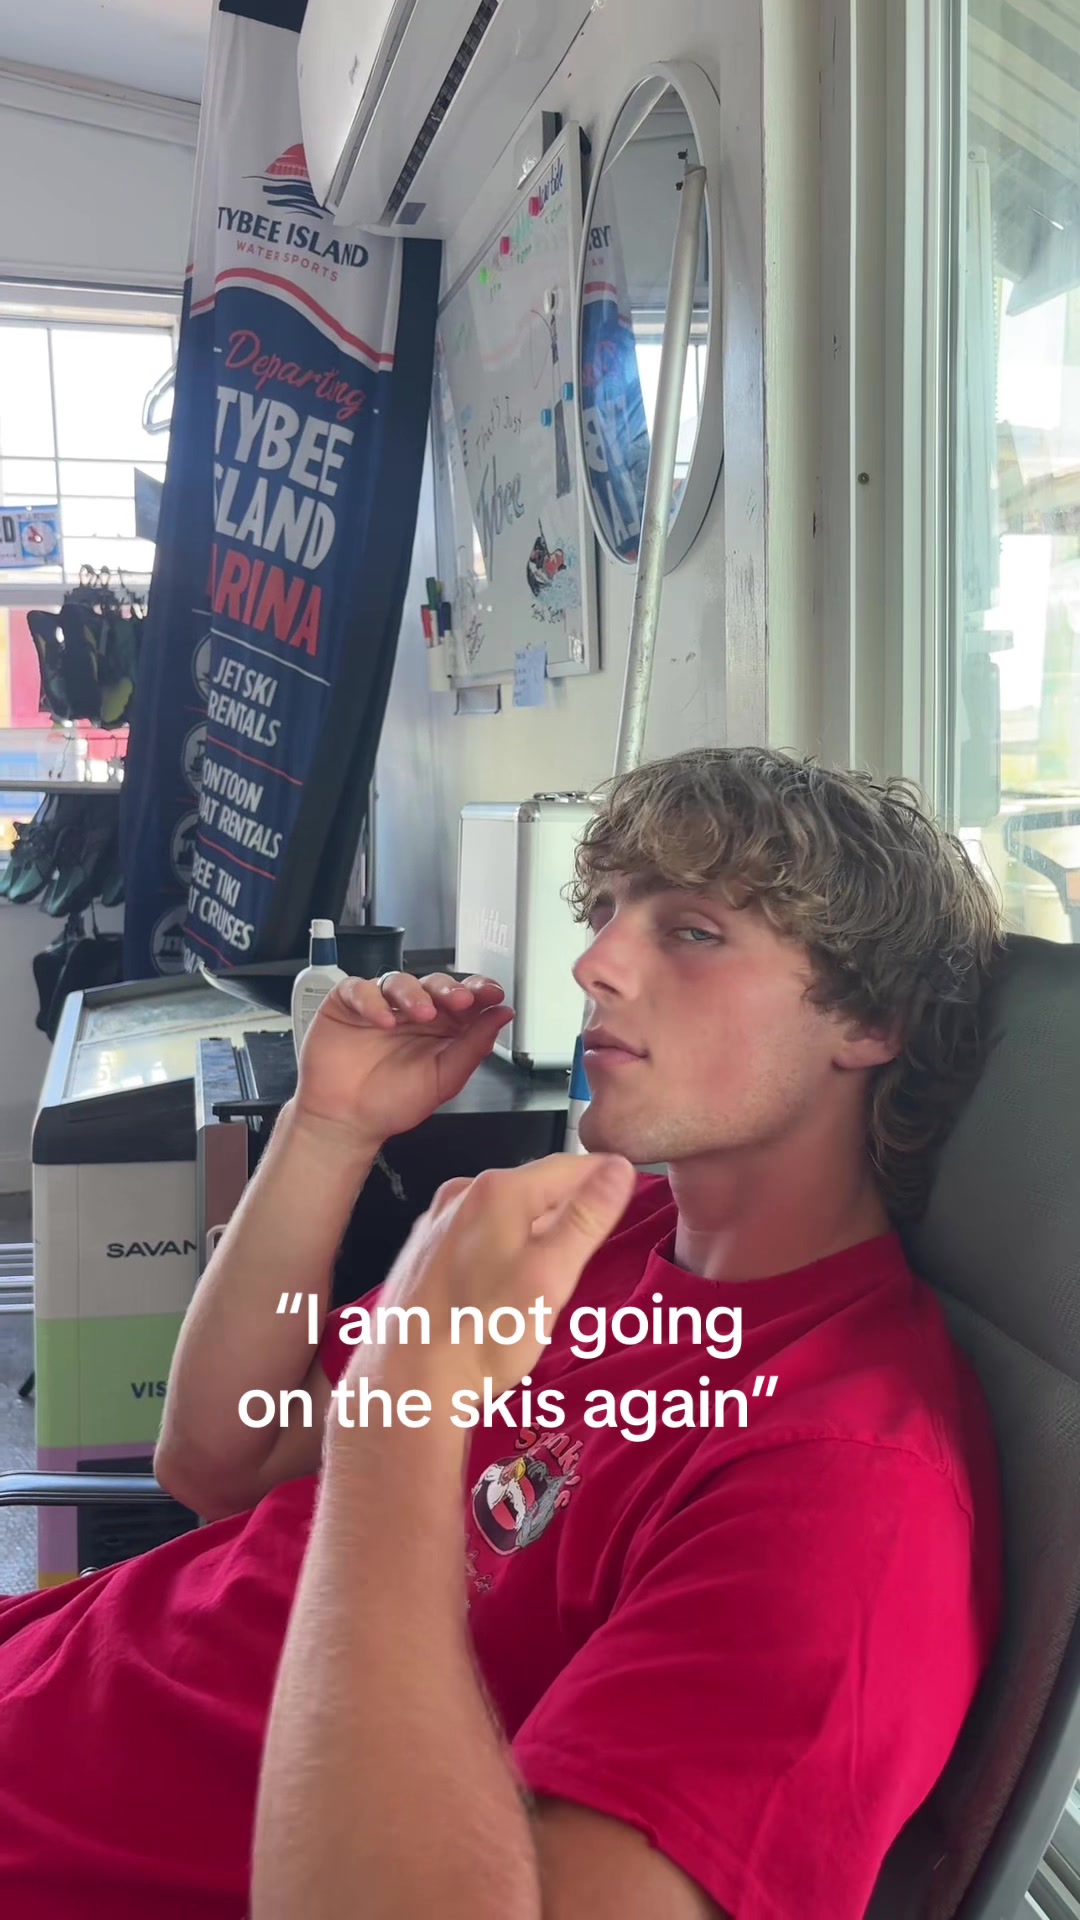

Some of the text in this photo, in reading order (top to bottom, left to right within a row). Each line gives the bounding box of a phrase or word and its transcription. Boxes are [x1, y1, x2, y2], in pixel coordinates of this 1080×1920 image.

[217, 206, 370, 269] TYBEE ISLAND
[214, 385, 355, 497] TYBEE
[212, 656, 279, 708] JET SKI
[207, 689, 282, 747] RENTALS
[202, 756, 265, 813] ONTOON
[217, 804, 284, 860] RENTALS
[215, 866, 242, 908] TIKI
[199, 895, 256, 952] CRUISES
